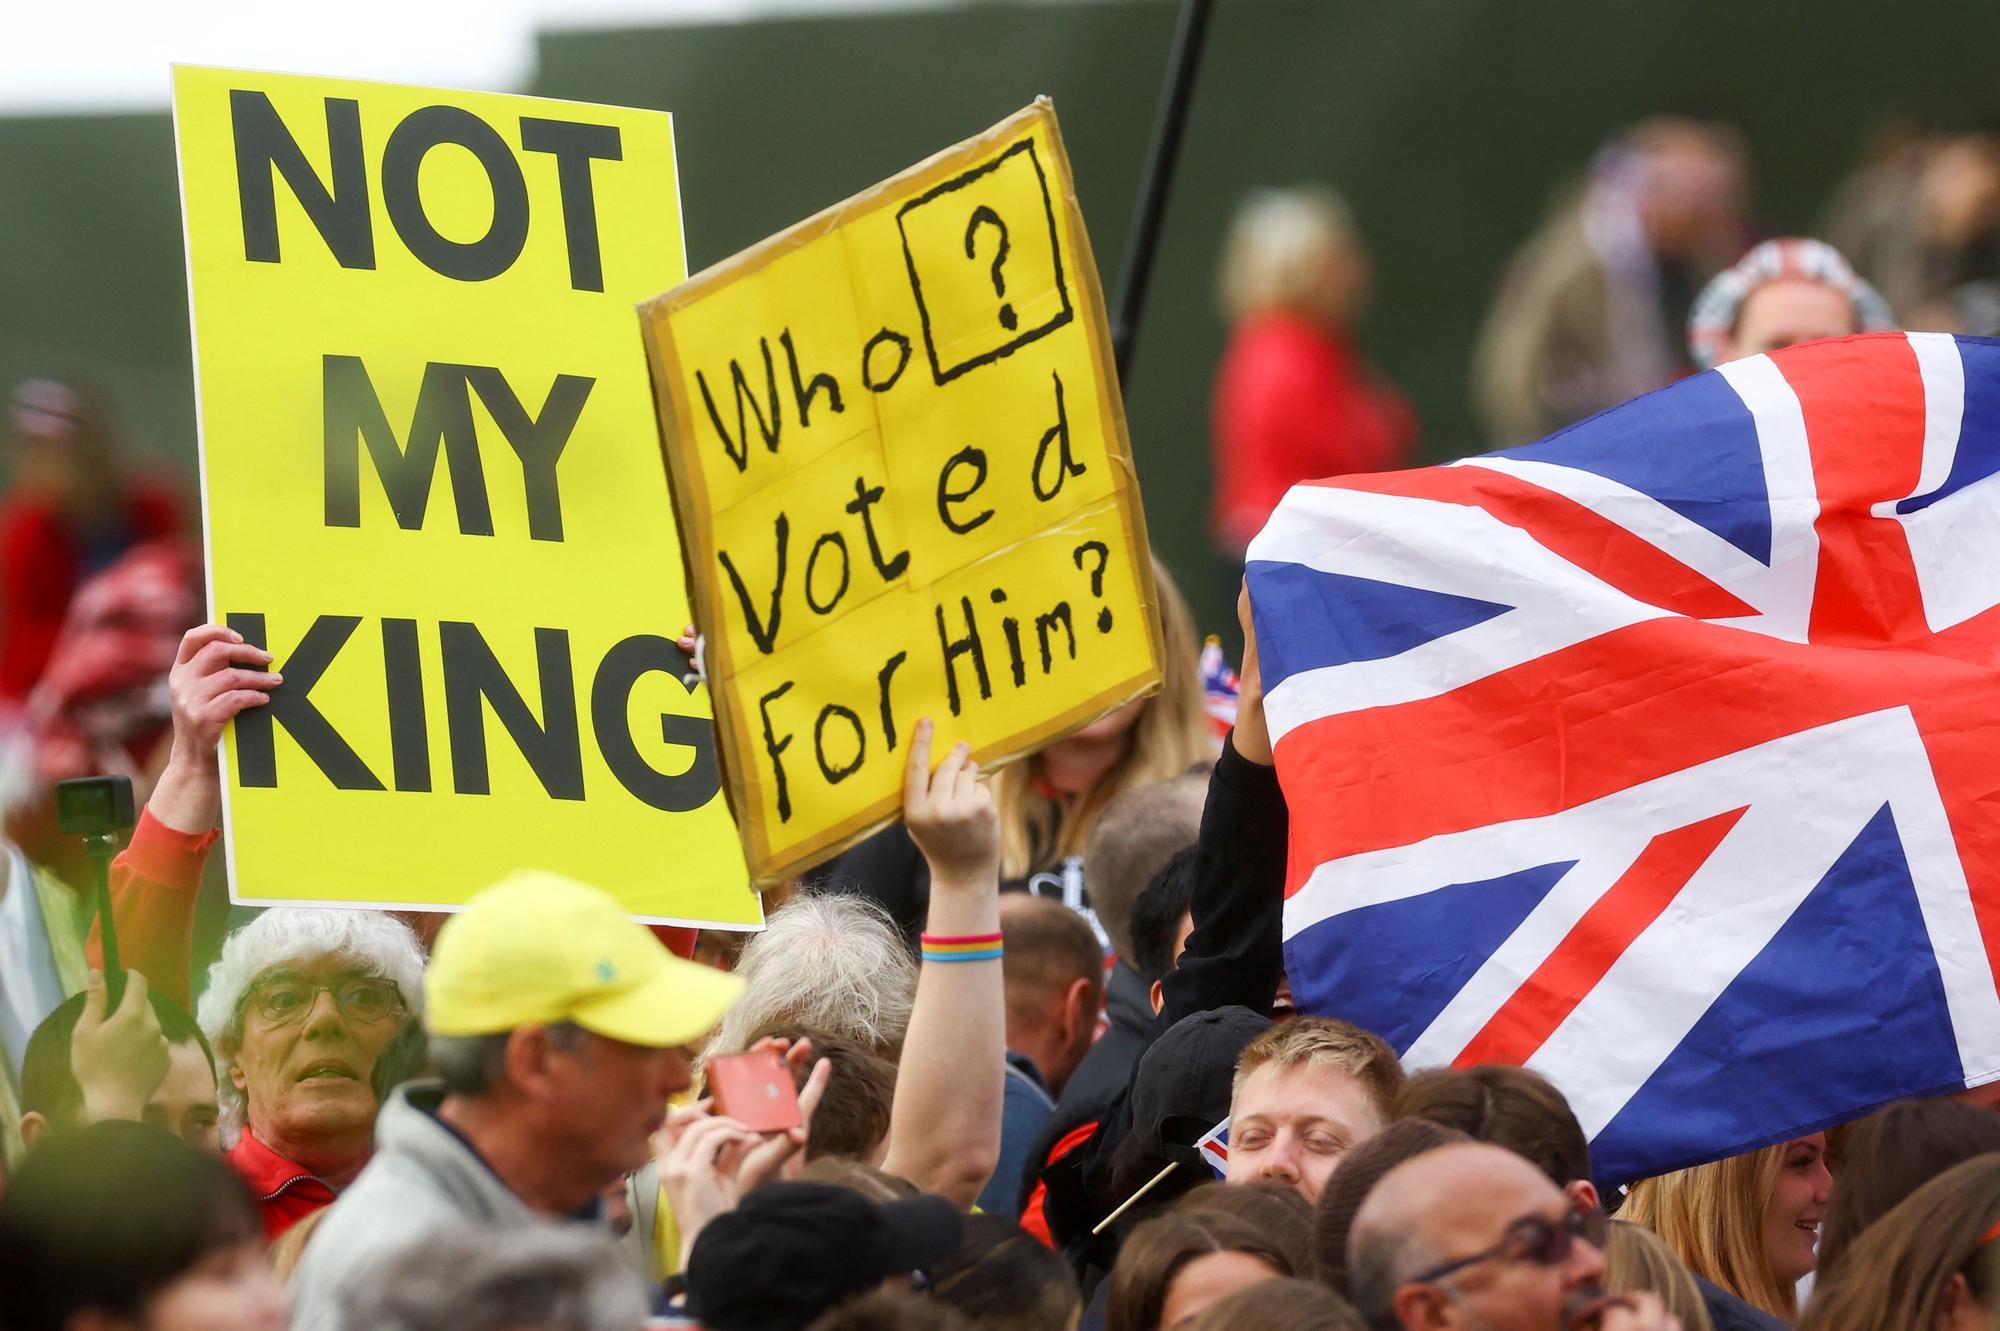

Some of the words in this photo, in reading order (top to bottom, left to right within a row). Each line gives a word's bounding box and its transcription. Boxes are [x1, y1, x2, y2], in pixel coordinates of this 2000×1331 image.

[229, 88, 624, 293] NOT
[322, 353, 597, 543] MY
[695, 327, 913, 473] Who
[965, 204, 1018, 331] ?
[717, 368, 1087, 654] Voted
[226, 612, 722, 813] KING
[759, 650, 907, 823] For
[935, 540, 1113, 717] Him?
